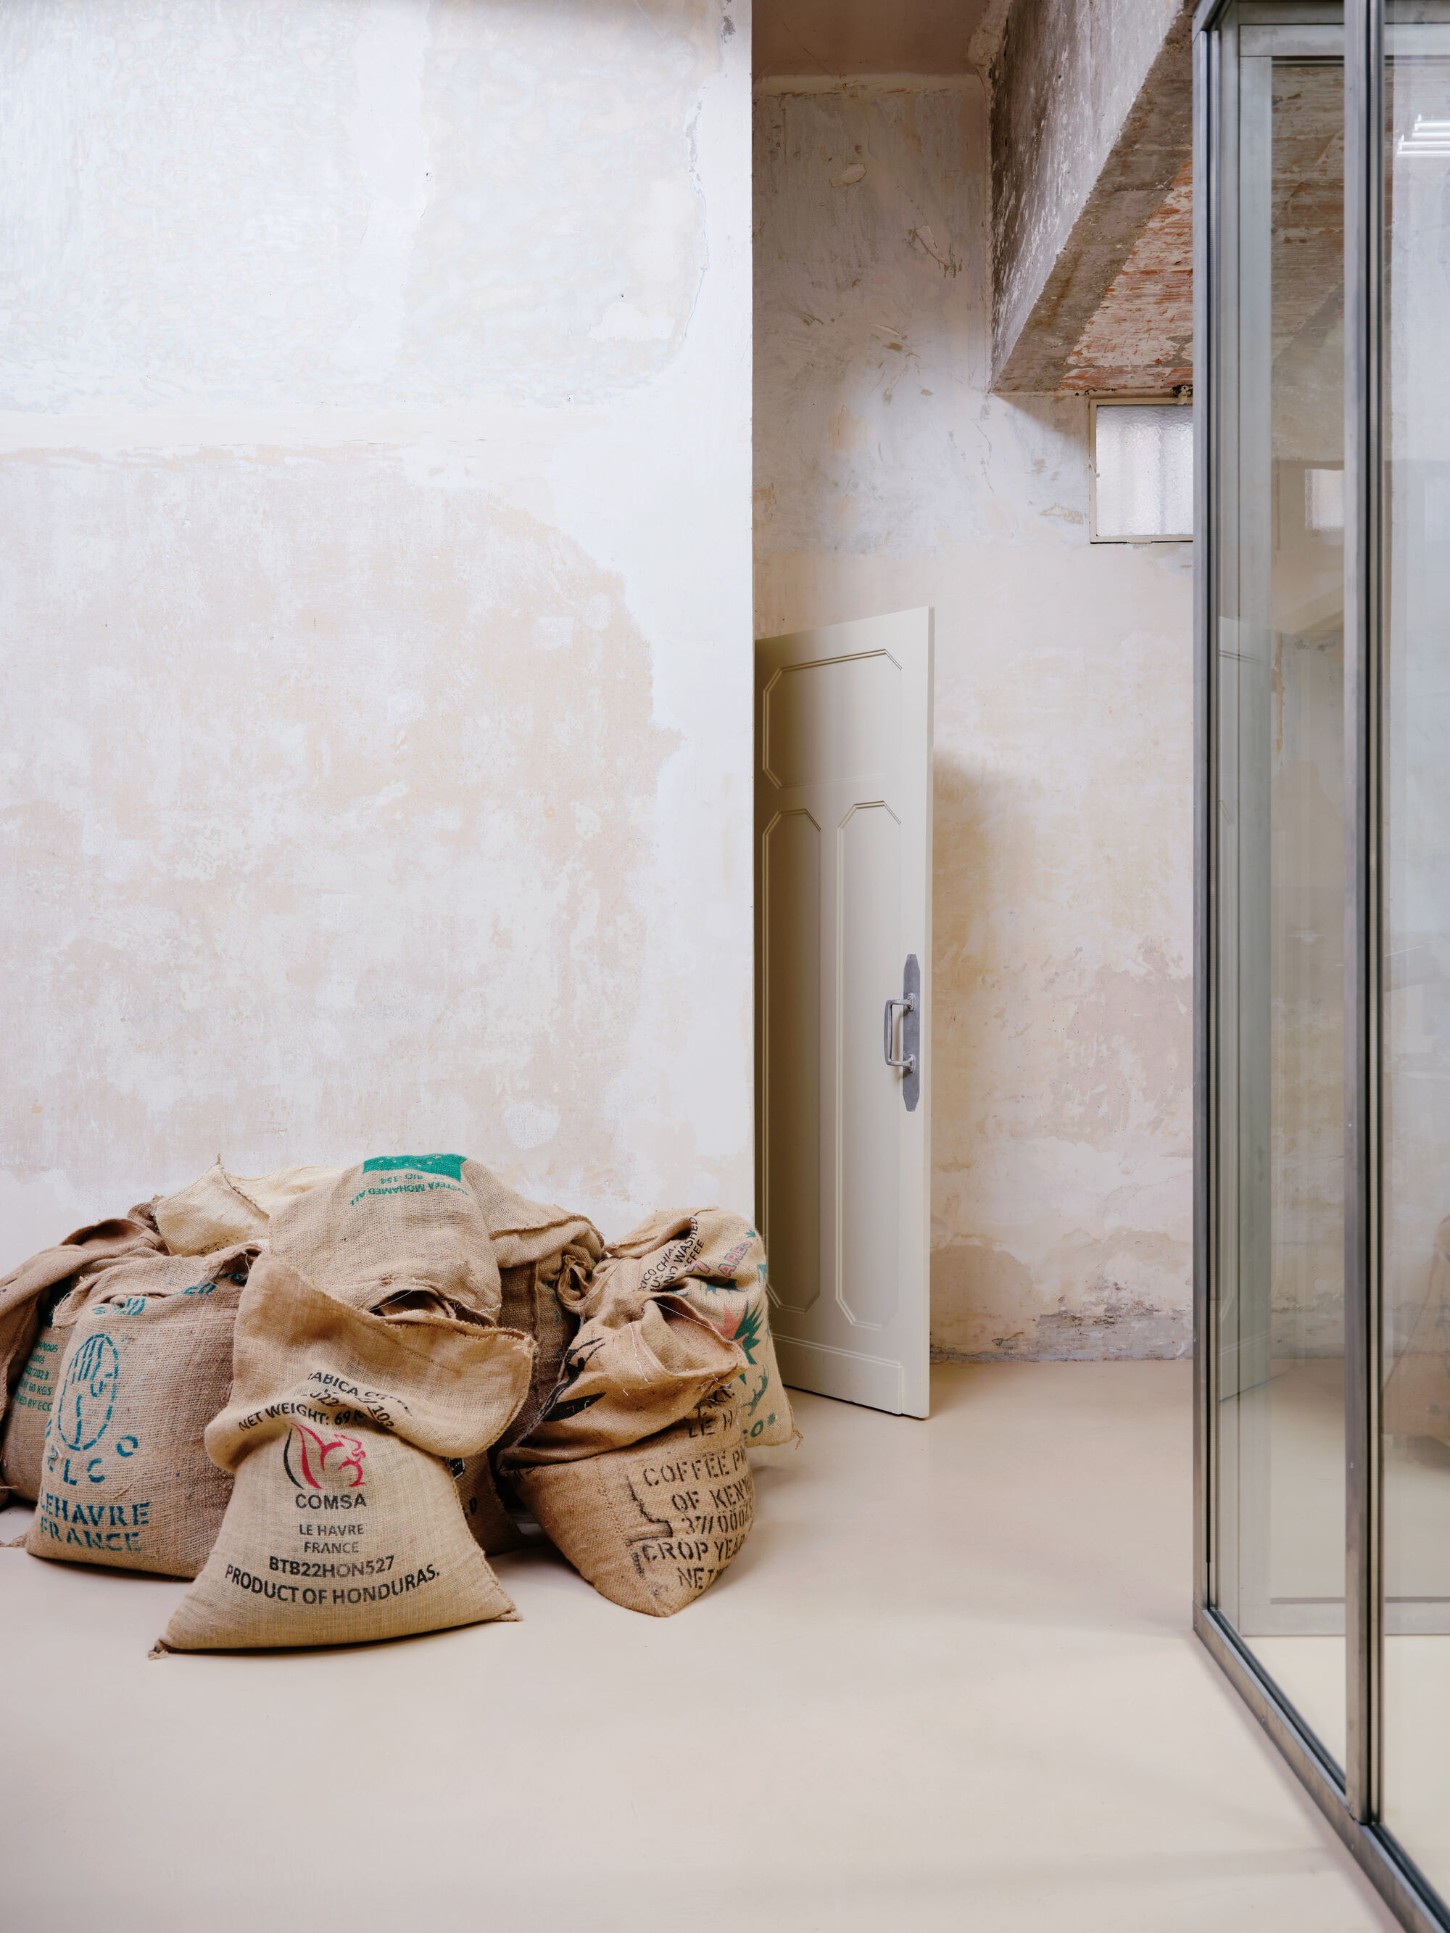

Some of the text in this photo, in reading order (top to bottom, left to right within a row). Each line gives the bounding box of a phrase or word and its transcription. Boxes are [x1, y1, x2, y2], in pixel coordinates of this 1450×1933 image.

[238, 1411, 262, 1432] NET
[265, 1402, 330, 1426] WEIGHT:
[643, 1454, 731, 1487] COFFEE
[295, 1493, 367, 1510] COMSA
[671, 1490, 699, 1512] OF
[40, 1516, 142, 1552] FRANCE
[299, 1523, 365, 1537] LE HAVRE
[303, 1541, 360, 1554] FRANCE
[641, 1540, 708, 1562] CROP
[269, 1555, 395, 1579] BTB22HON527
[224, 1563, 441, 1605] PRODUCT OF HONDURAS.
